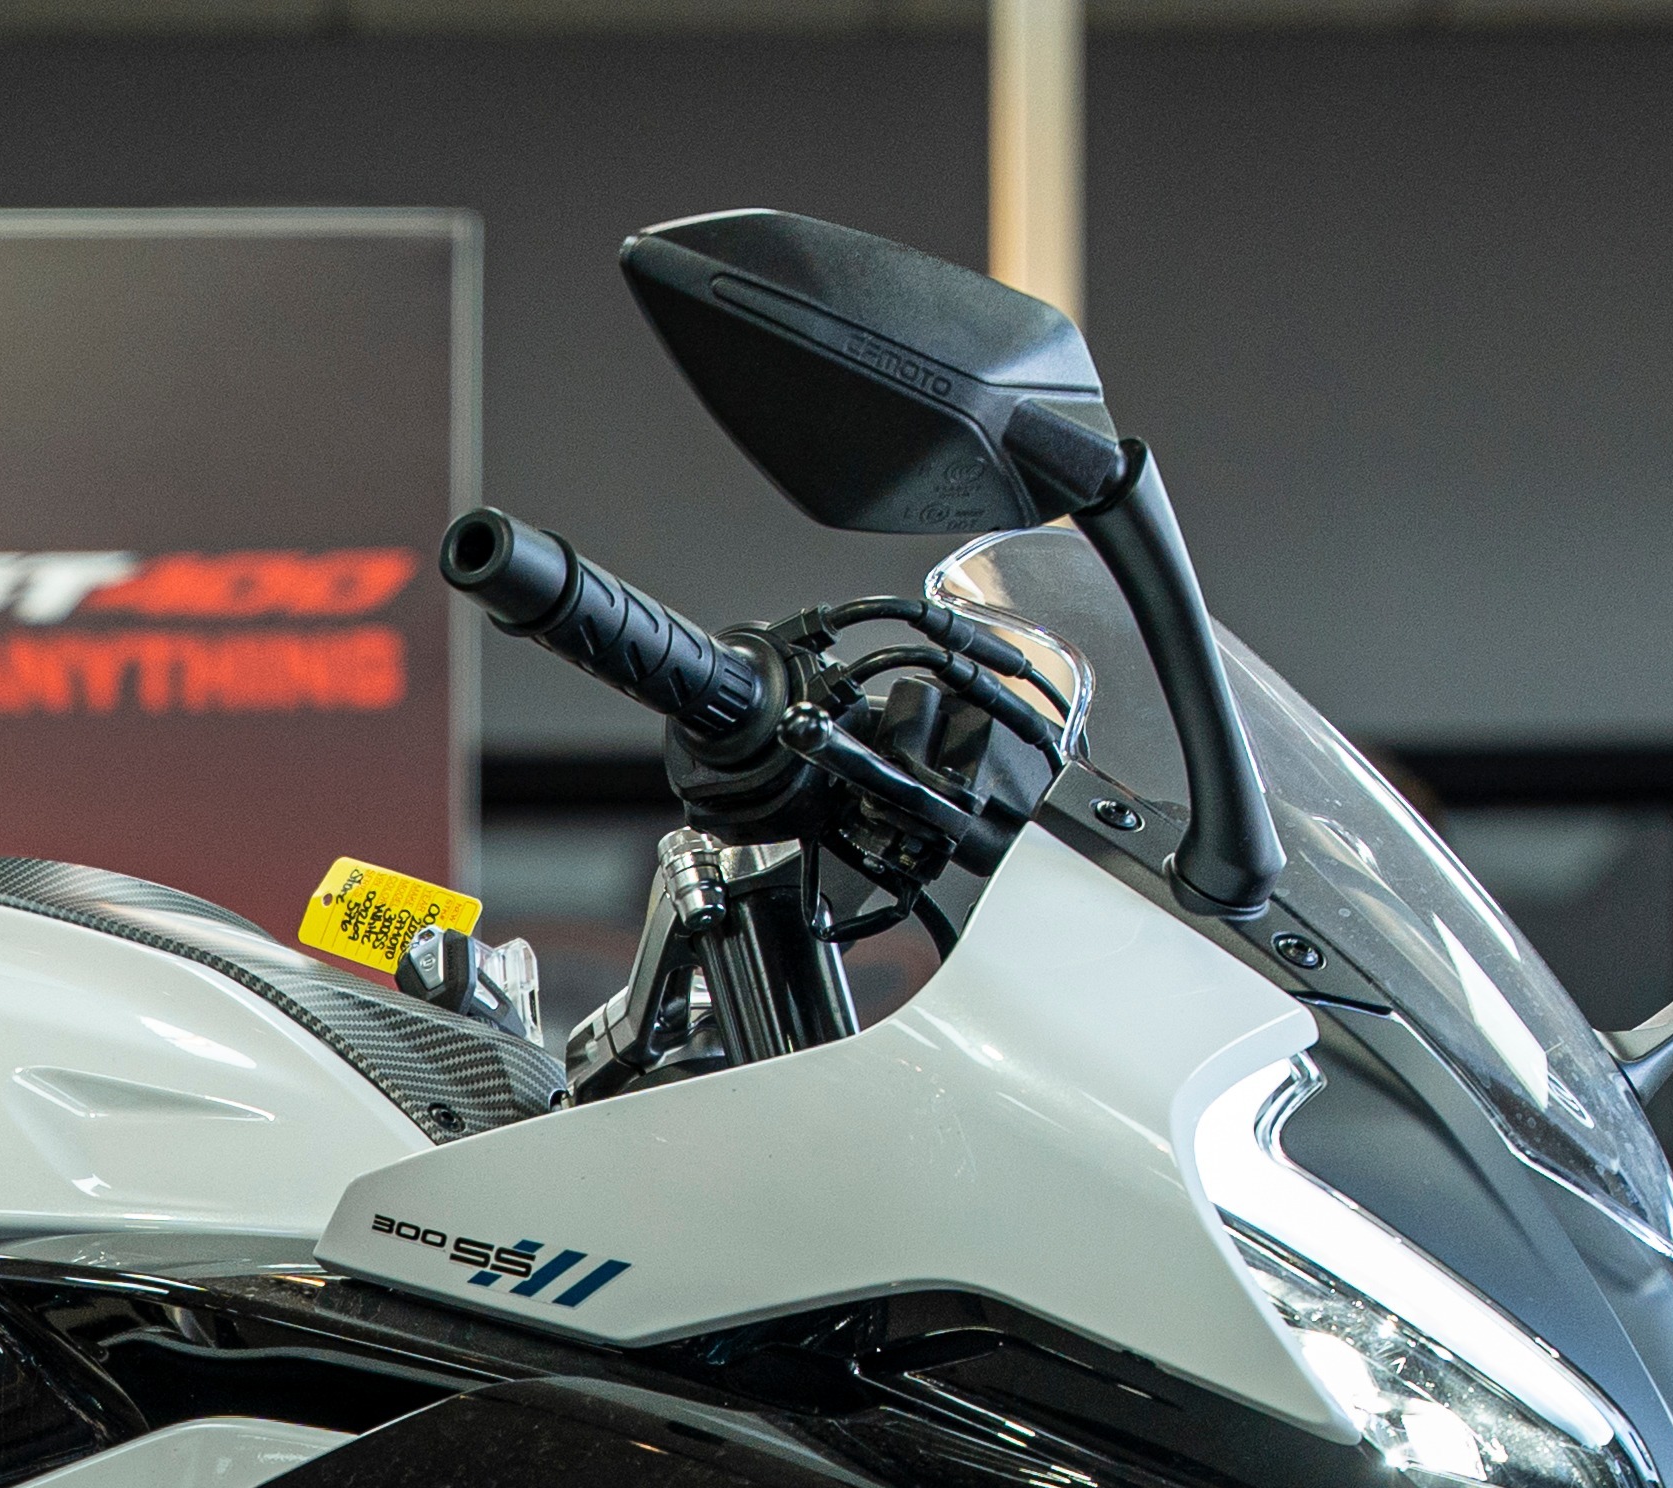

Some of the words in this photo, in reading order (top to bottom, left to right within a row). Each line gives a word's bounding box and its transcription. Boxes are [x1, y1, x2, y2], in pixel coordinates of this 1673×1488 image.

[843, 333, 952, 397] CFMOTO
[372, 1213, 448, 1248] 300
[449, 1236, 537, 1279] SS
